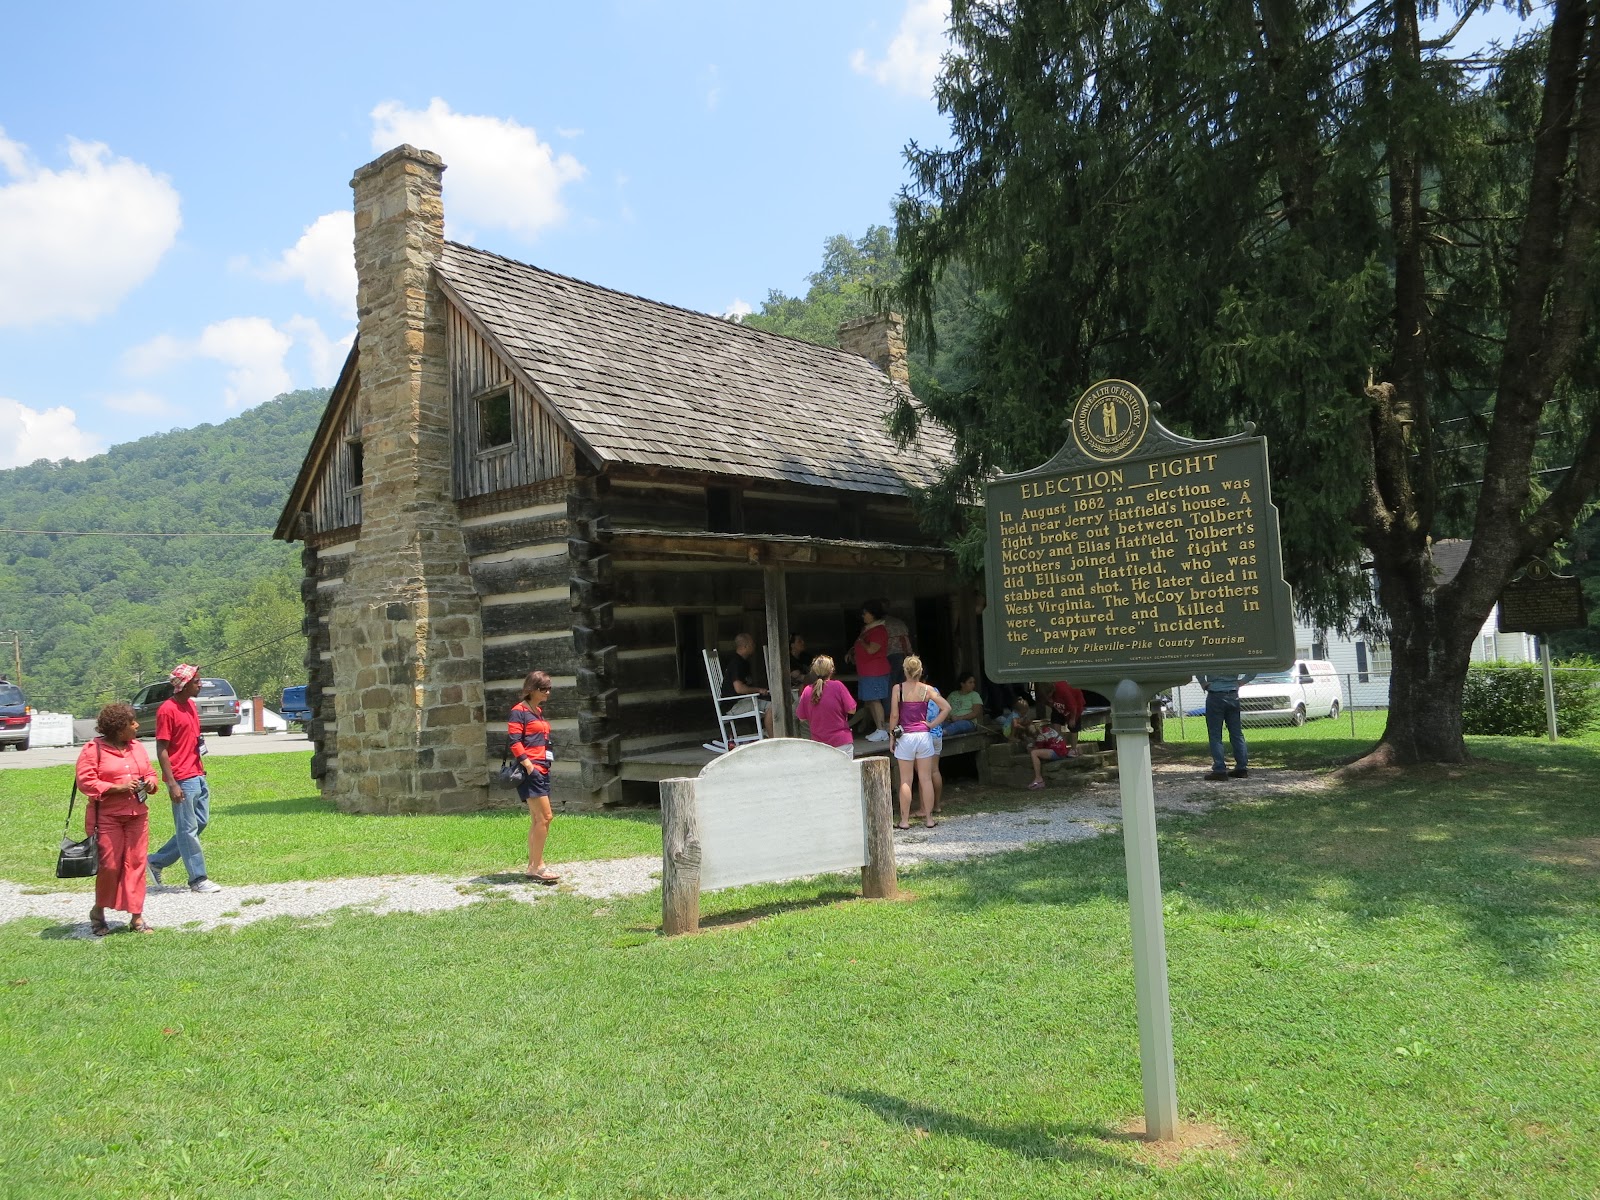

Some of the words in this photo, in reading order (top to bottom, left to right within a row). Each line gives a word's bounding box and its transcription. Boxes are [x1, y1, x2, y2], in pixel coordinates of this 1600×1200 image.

[1079, 387, 1109, 441] COMMONWEALTH
[1110, 386, 1120, 394] OF
[1119, 388, 1141, 428] KENTUCKY
[1021, 469, 1123, 499] ELECTION
[1148, 454, 1218, 480] FIGHT
[1000, 511, 1012, 522] In
[1021, 503, 1067, 520] August
[1074, 497, 1105, 513] 1882
[1116, 495, 1135, 506] an
[1146, 484, 1211, 502] election
[1221, 479, 1250, 490] was
[1000, 522, 1027, 536] held
[1031, 519, 1061, 532] near
[1065, 513, 1104, 527] Jerry
[1108, 501, 1177, 522] Hatfield's
[1182, 497, 1230, 512] house.
[1240, 491, 1252, 504] A
[1001, 535, 1034, 550] fight
[1040, 530, 1078, 545] broke
[1086, 525, 1110, 538] out
[1118, 517, 1184, 535] between
[1189, 506, 1253, 525] Tolbert
[1002, 548, 1045, 562] McCoy
[1049, 544, 1073, 557] and
[1078, 541, 1111, 554] Elias
[1115, 531, 1179, 549] Hatfield.
[1185, 522, 1255, 540] Tolbert's
[1003, 561, 1061, 576] brothers
[1070, 552, 1116, 571] joined
[1125, 551, 1140, 562] in
[1150, 547, 1175, 560] the
[1187, 540, 1228, 557] fight
[1239, 539, 1256, 550] as
[1003, 577, 1025, 589] did
[1036, 572, 1084, 586] Ellison
[1181, 558, 1211, 571] who
[1227, 554, 1257, 567] was
[1004, 587, 1055, 602] stabbed
[1060, 584, 1085, 597] and
[1090, 581, 1123, 595] shot.
[1131, 578, 1151, 591] He
[1156, 575, 1193, 589] later
[1200, 569, 1235, 584] died
[1242, 569, 1258, 581] in
[1005, 603, 1034, 615] West
[1037, 599, 1095, 614] Virginia.
[1102, 595, 1130, 608] The
[1134, 591, 1184, 605] McCoy
[1190, 584, 1259, 601] brothers
[1006, 619, 1036, 628] were
[1050, 609, 1115, 628] captured
[1131, 606, 1159, 620] and
[1177, 600, 1225, 617] killed
[1243, 600, 1260, 612] in
[1006, 631, 1029, 642] the
[1035, 626, 1097, 643] "pawpaw
[1105, 620, 1145, 636] tree"
[1154, 617, 1225, 633] incident.
[1021, 645, 1064, 656] Presented
[1068, 644, 1079, 655] by
[1083, 638, 1153, 653] Pikeville-Pike
[1158, 637, 1195, 648] County
[1202, 635, 1245, 645] Tourism
